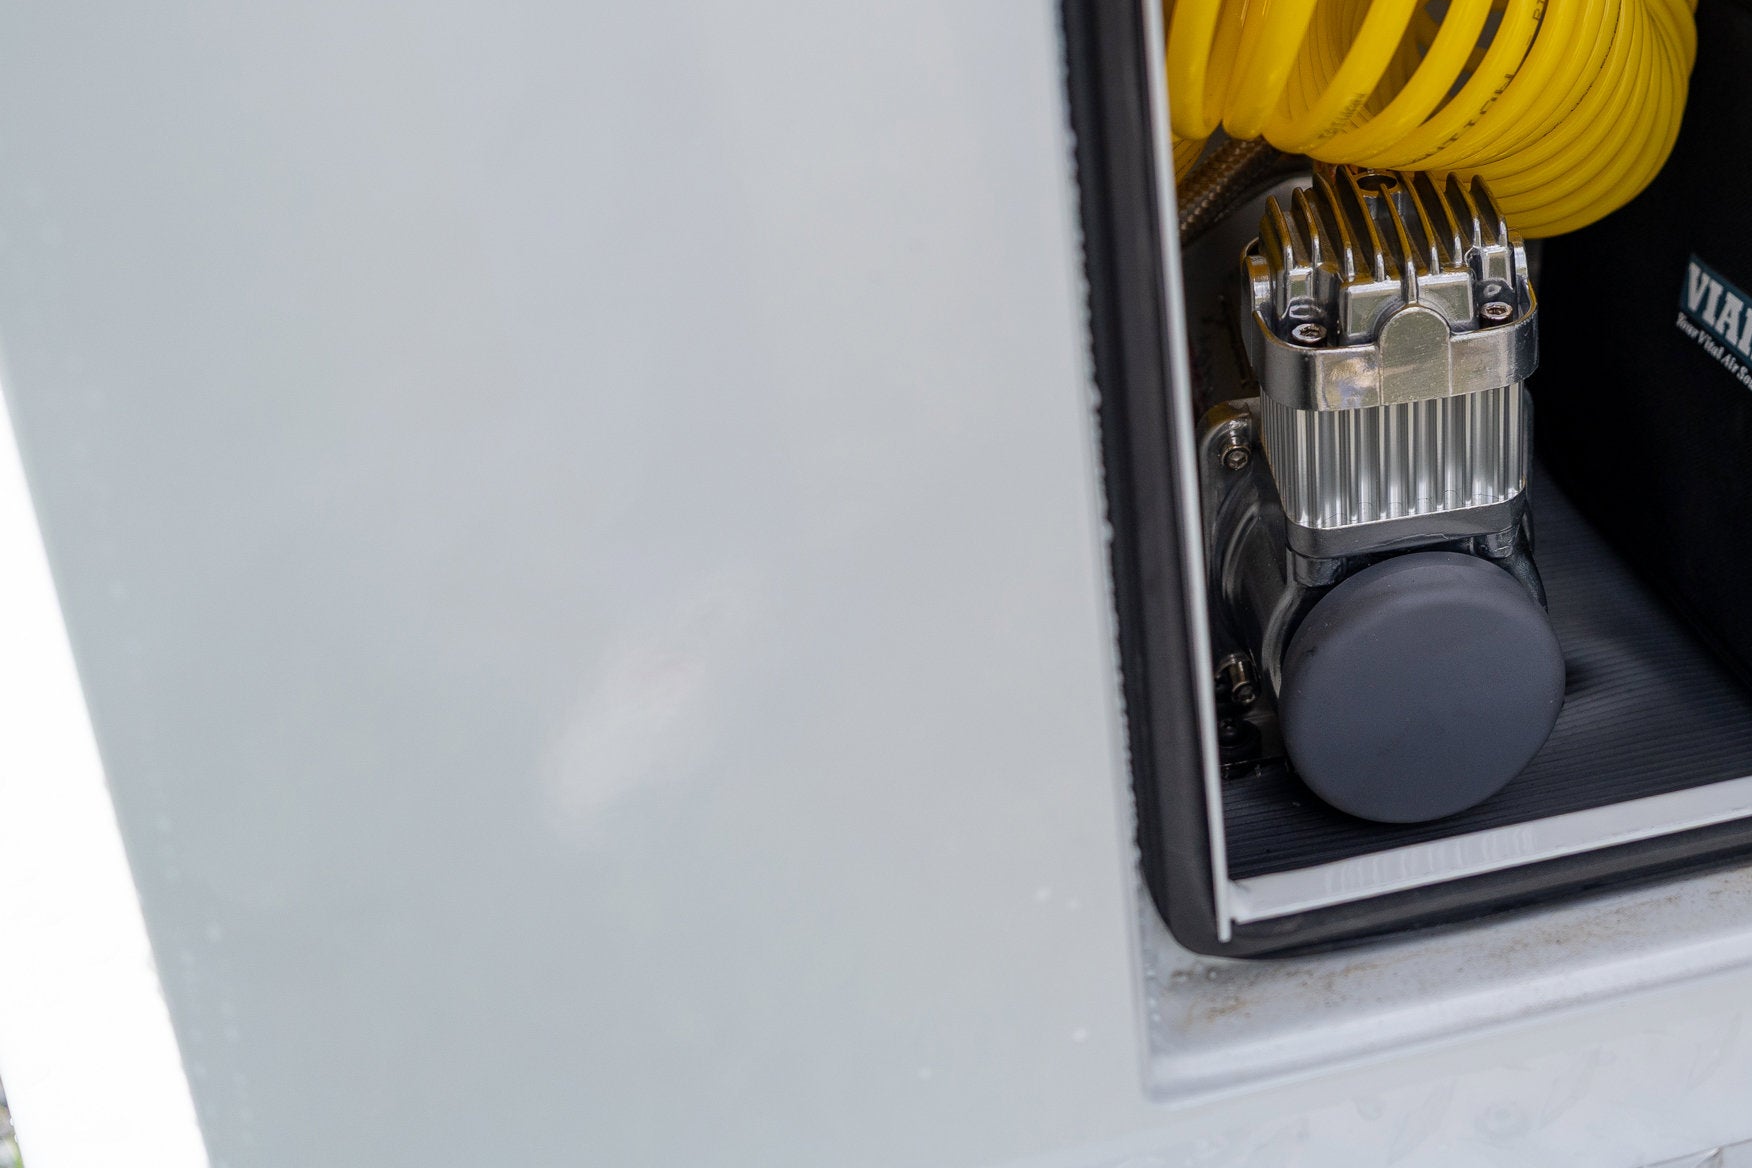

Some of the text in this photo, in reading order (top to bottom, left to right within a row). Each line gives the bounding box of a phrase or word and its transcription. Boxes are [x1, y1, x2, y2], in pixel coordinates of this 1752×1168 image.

[1675, 311, 1698, 338] Your
[1698, 330, 1725, 360] Vital
[1721, 353, 1739, 374] Air
